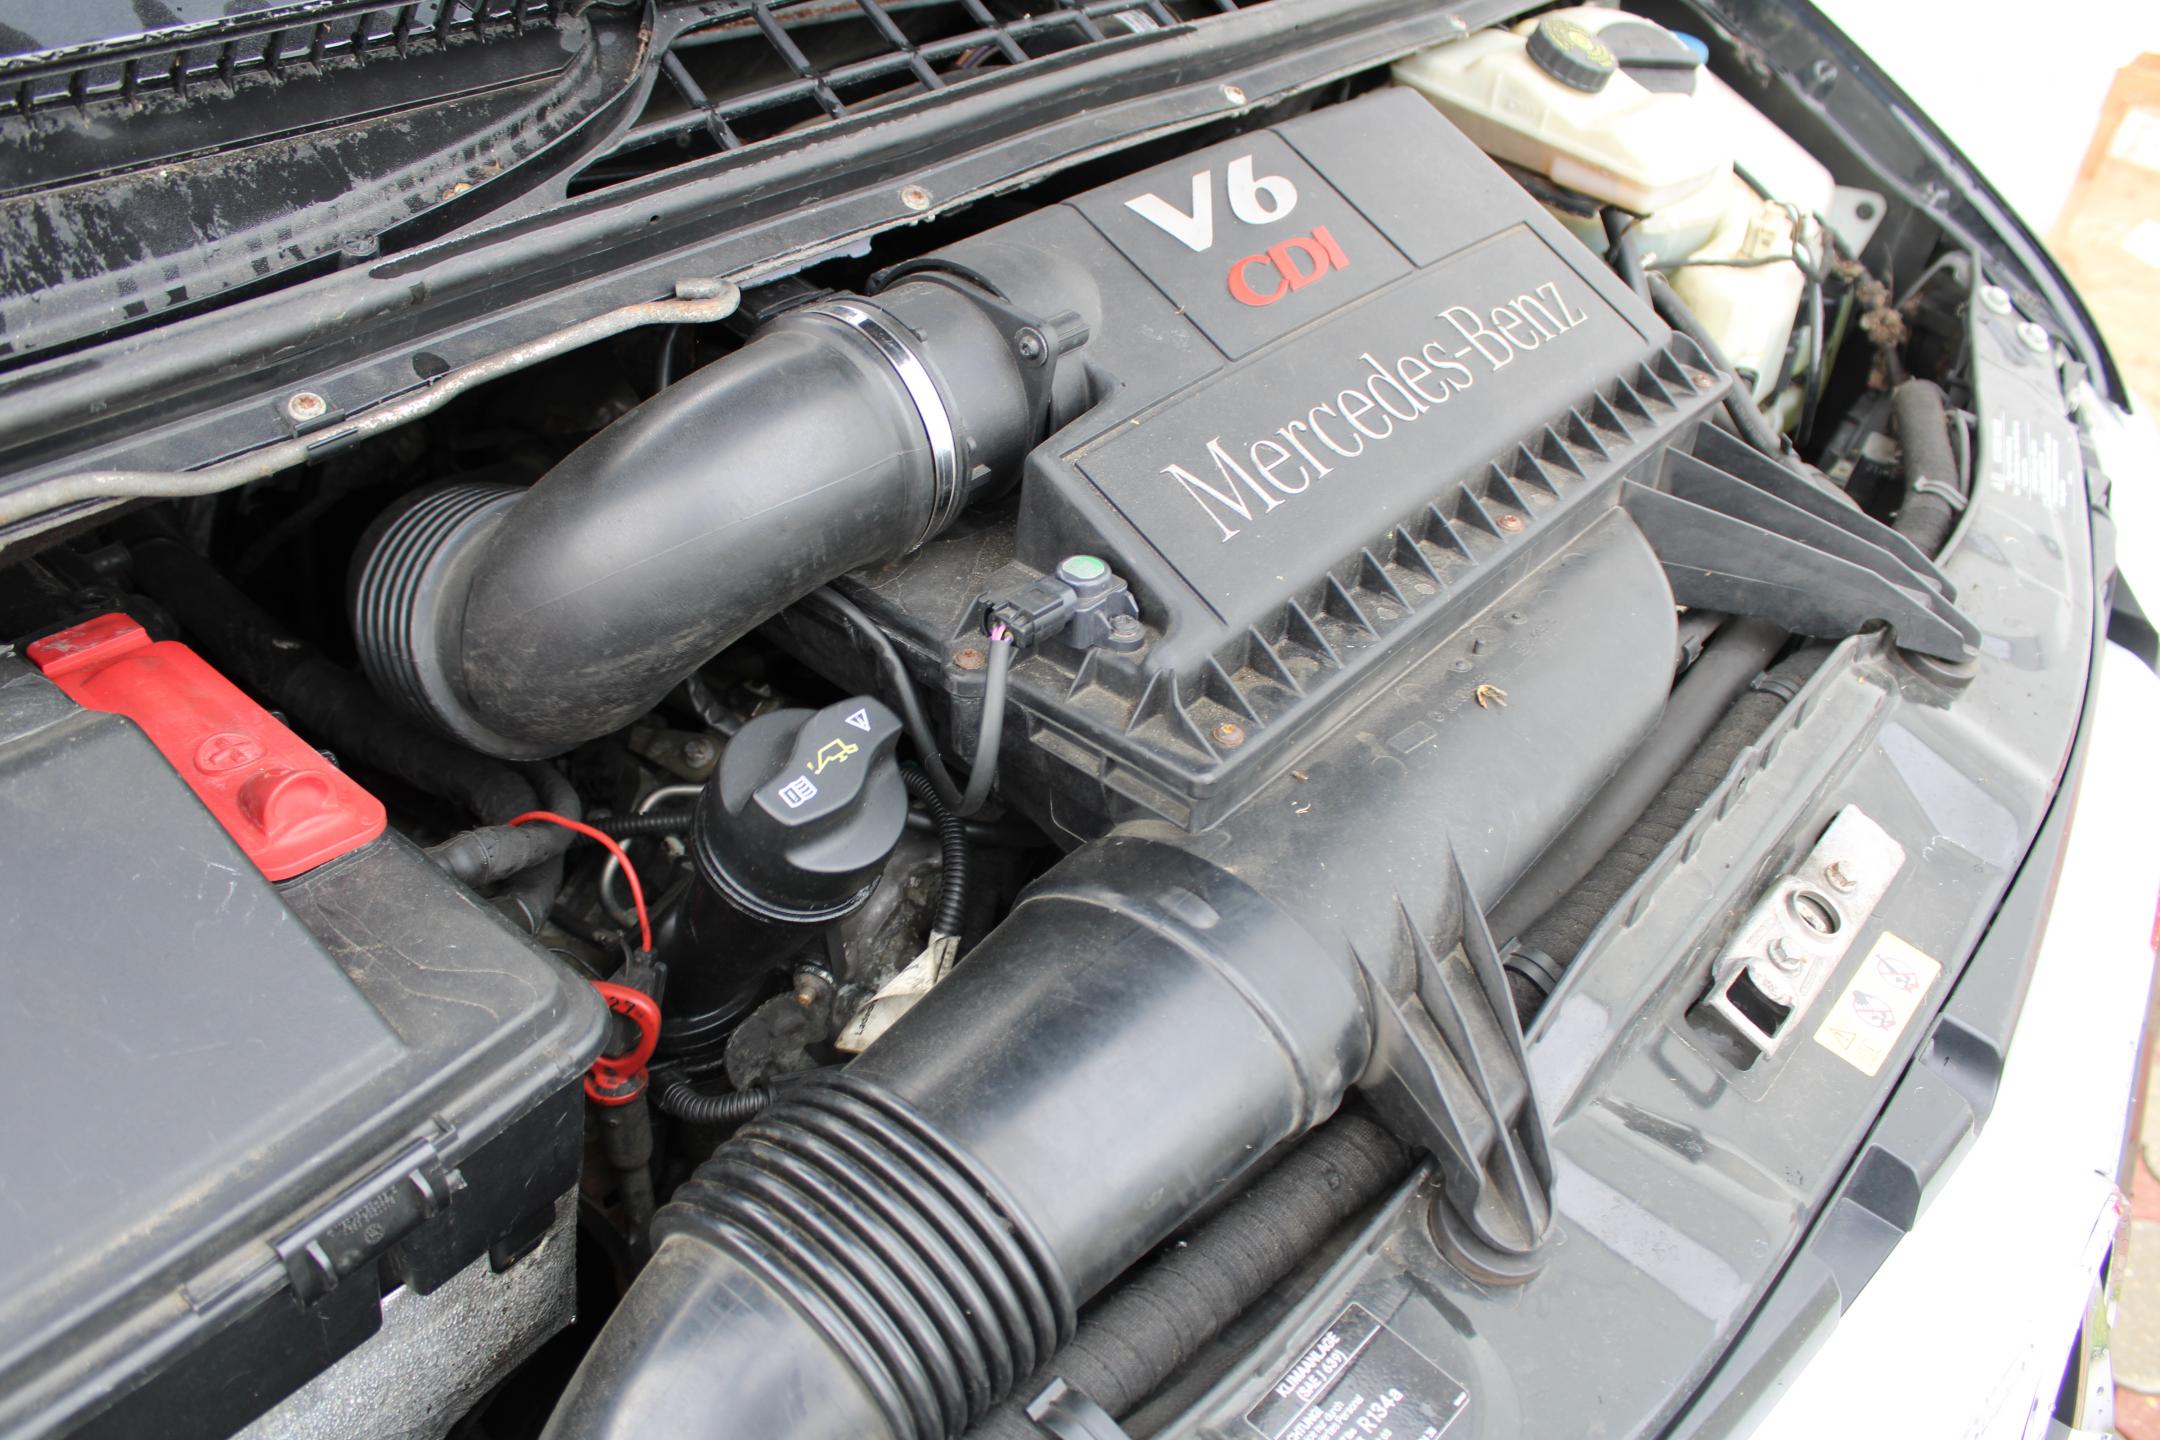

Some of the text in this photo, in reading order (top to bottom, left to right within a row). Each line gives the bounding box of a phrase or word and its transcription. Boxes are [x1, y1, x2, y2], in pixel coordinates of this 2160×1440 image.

[1123, 153, 1298, 252] V6
[1226, 225, 1351, 306] CDI
[1159, 281, 1588, 543] Mercedes-Benz
[1275, 1331, 1341, 1398] KLIMAANLAGE
[1286, 1405, 1324, 1440] CHTUNG!
[1356, 1388, 1404, 1434] R134a
